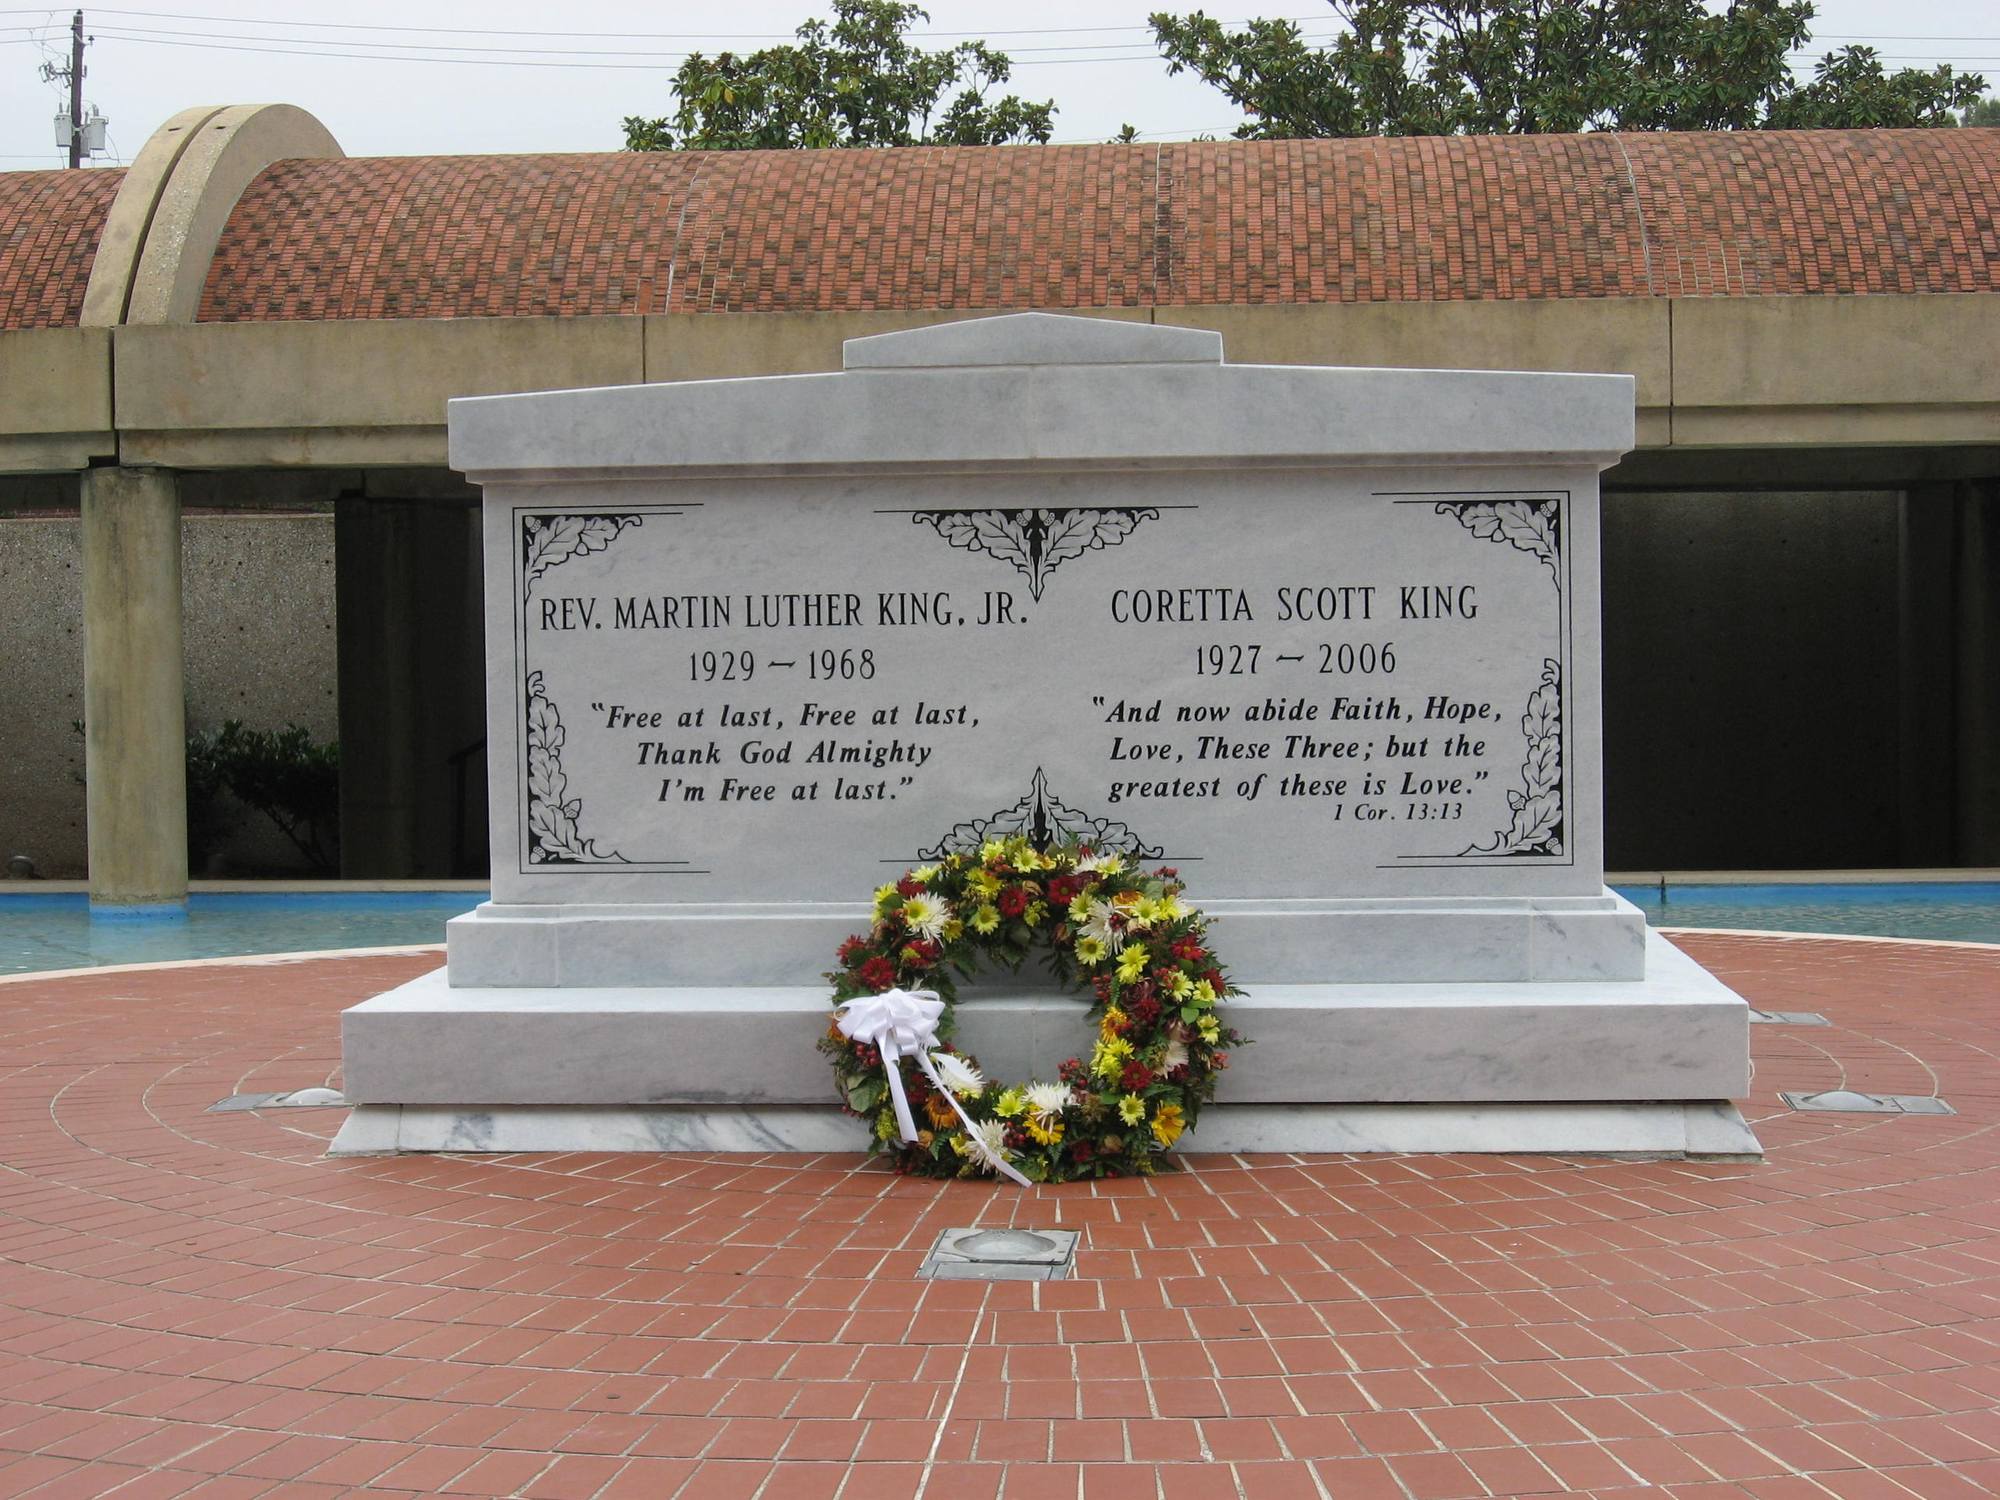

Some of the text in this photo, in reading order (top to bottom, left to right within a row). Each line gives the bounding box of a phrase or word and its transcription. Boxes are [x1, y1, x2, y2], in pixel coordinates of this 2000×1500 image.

[539, 591, 1028, 631] REV. MARTIN LUTHER KING, JR.
[1111, 585, 1479, 624] CORETTA SCOTT KING
[689, 650, 755, 683] 1929
[808, 648, 876, 681] 1968
[1196, 644, 1262, 677] 1927
[1318, 641, 1396, 675] 2006
[677, 707, 705, 729] at
[719, 703, 784, 731] last,
[799, 702, 857, 727] Free
[871, 705, 900, 726] at
[914, 701, 979, 729] last,
[1175, 705, 1231, 723] now
[1244, 697, 1319, 723] abide
[1329, 696, 1414, 724] Faith,
[1423, 695, 1502, 725] Hope,
[637, 738, 932, 769] Thank God Almighty
[1109, 732, 1486, 765] Love, These Three; but the
[718, 777, 776, 802] Free
[791, 780, 819, 801] at
[1107, 776, 1221, 804] greatest
[1236, 772, 1269, 802] of
[1279, 772, 1348, 797] these
[1362, 771, 1387, 796] is
[1333, 802, 1463, 821] 1 Cor. 13:13
